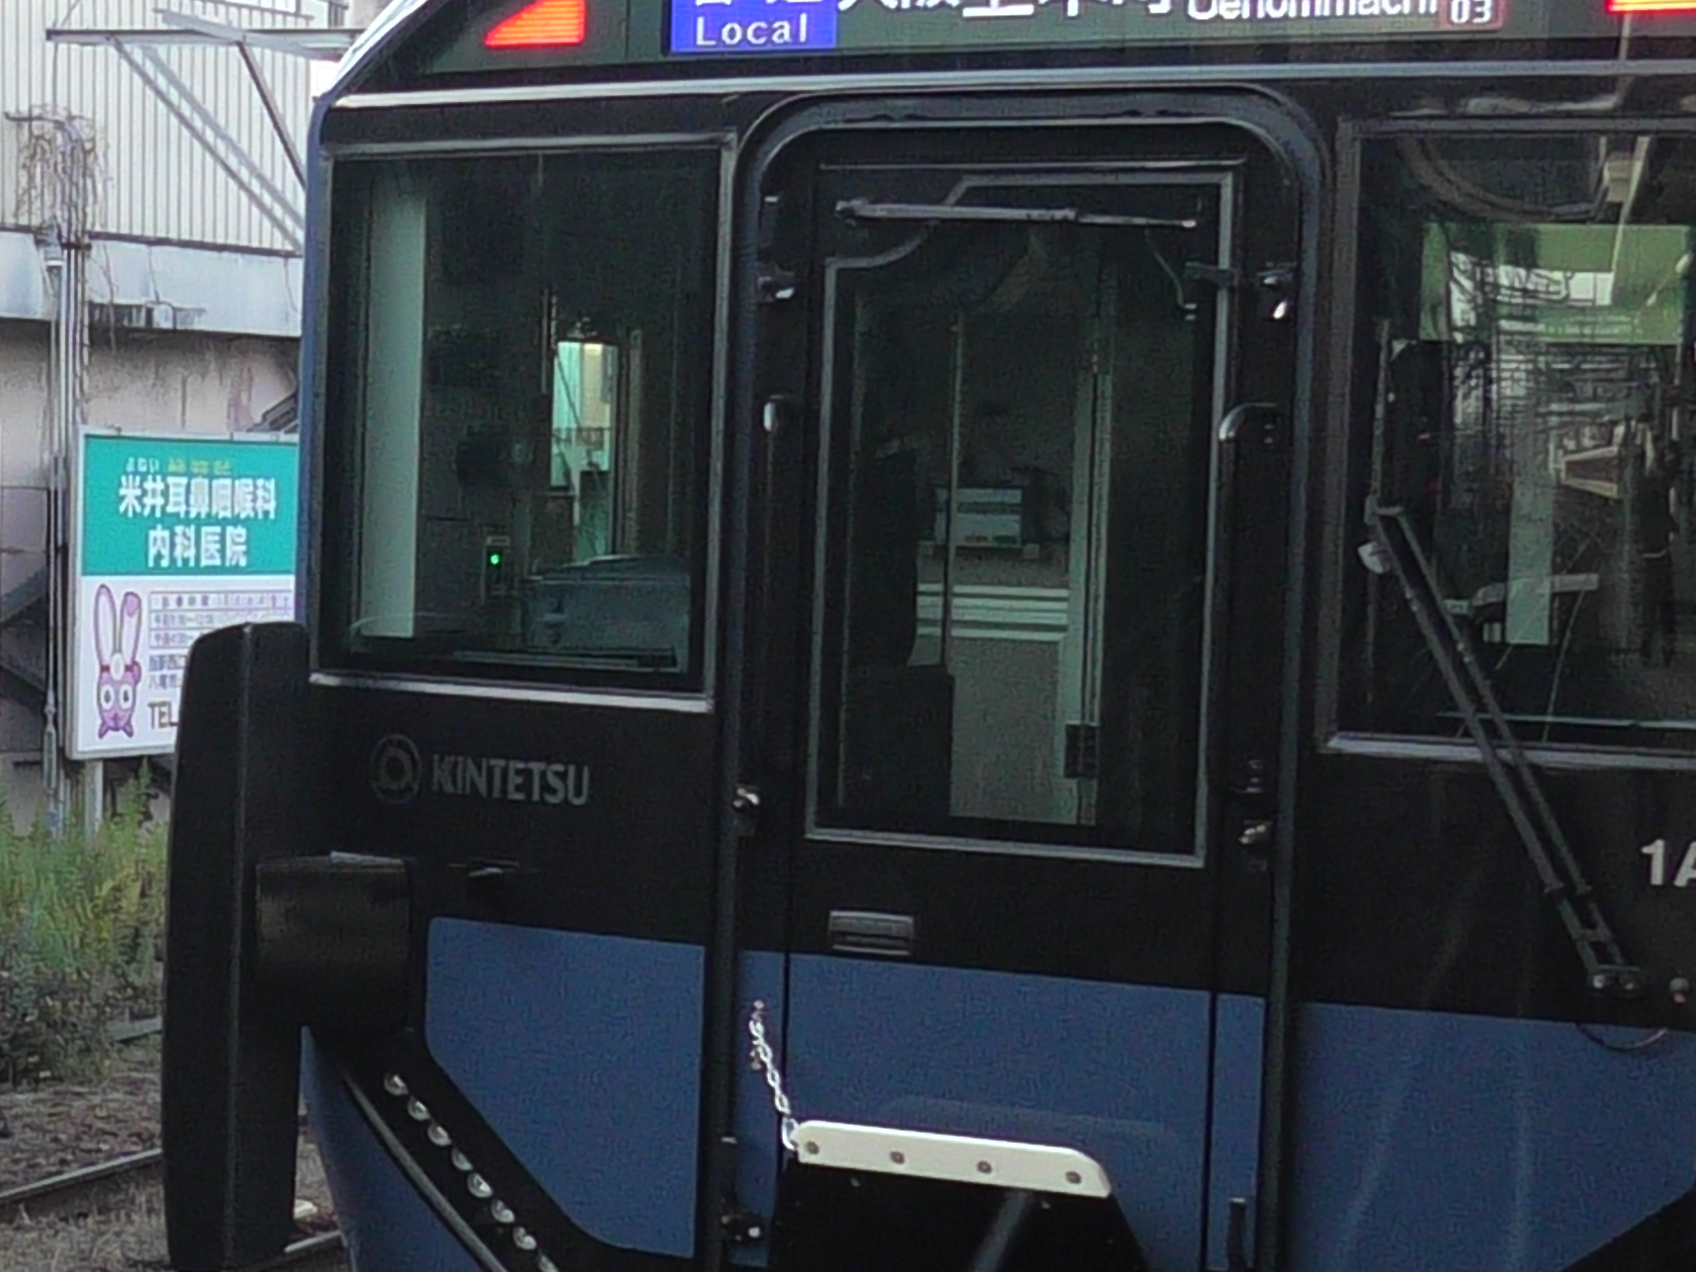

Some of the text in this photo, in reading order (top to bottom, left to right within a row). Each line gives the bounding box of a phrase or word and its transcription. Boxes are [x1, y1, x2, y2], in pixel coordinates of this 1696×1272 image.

[695, 12, 809, 47] Local
[118, 474, 276, 520] 米井耳鼻咽喉科
[147, 524, 247, 569] 内科医院
[431, 752, 592, 806] KINTETSU
